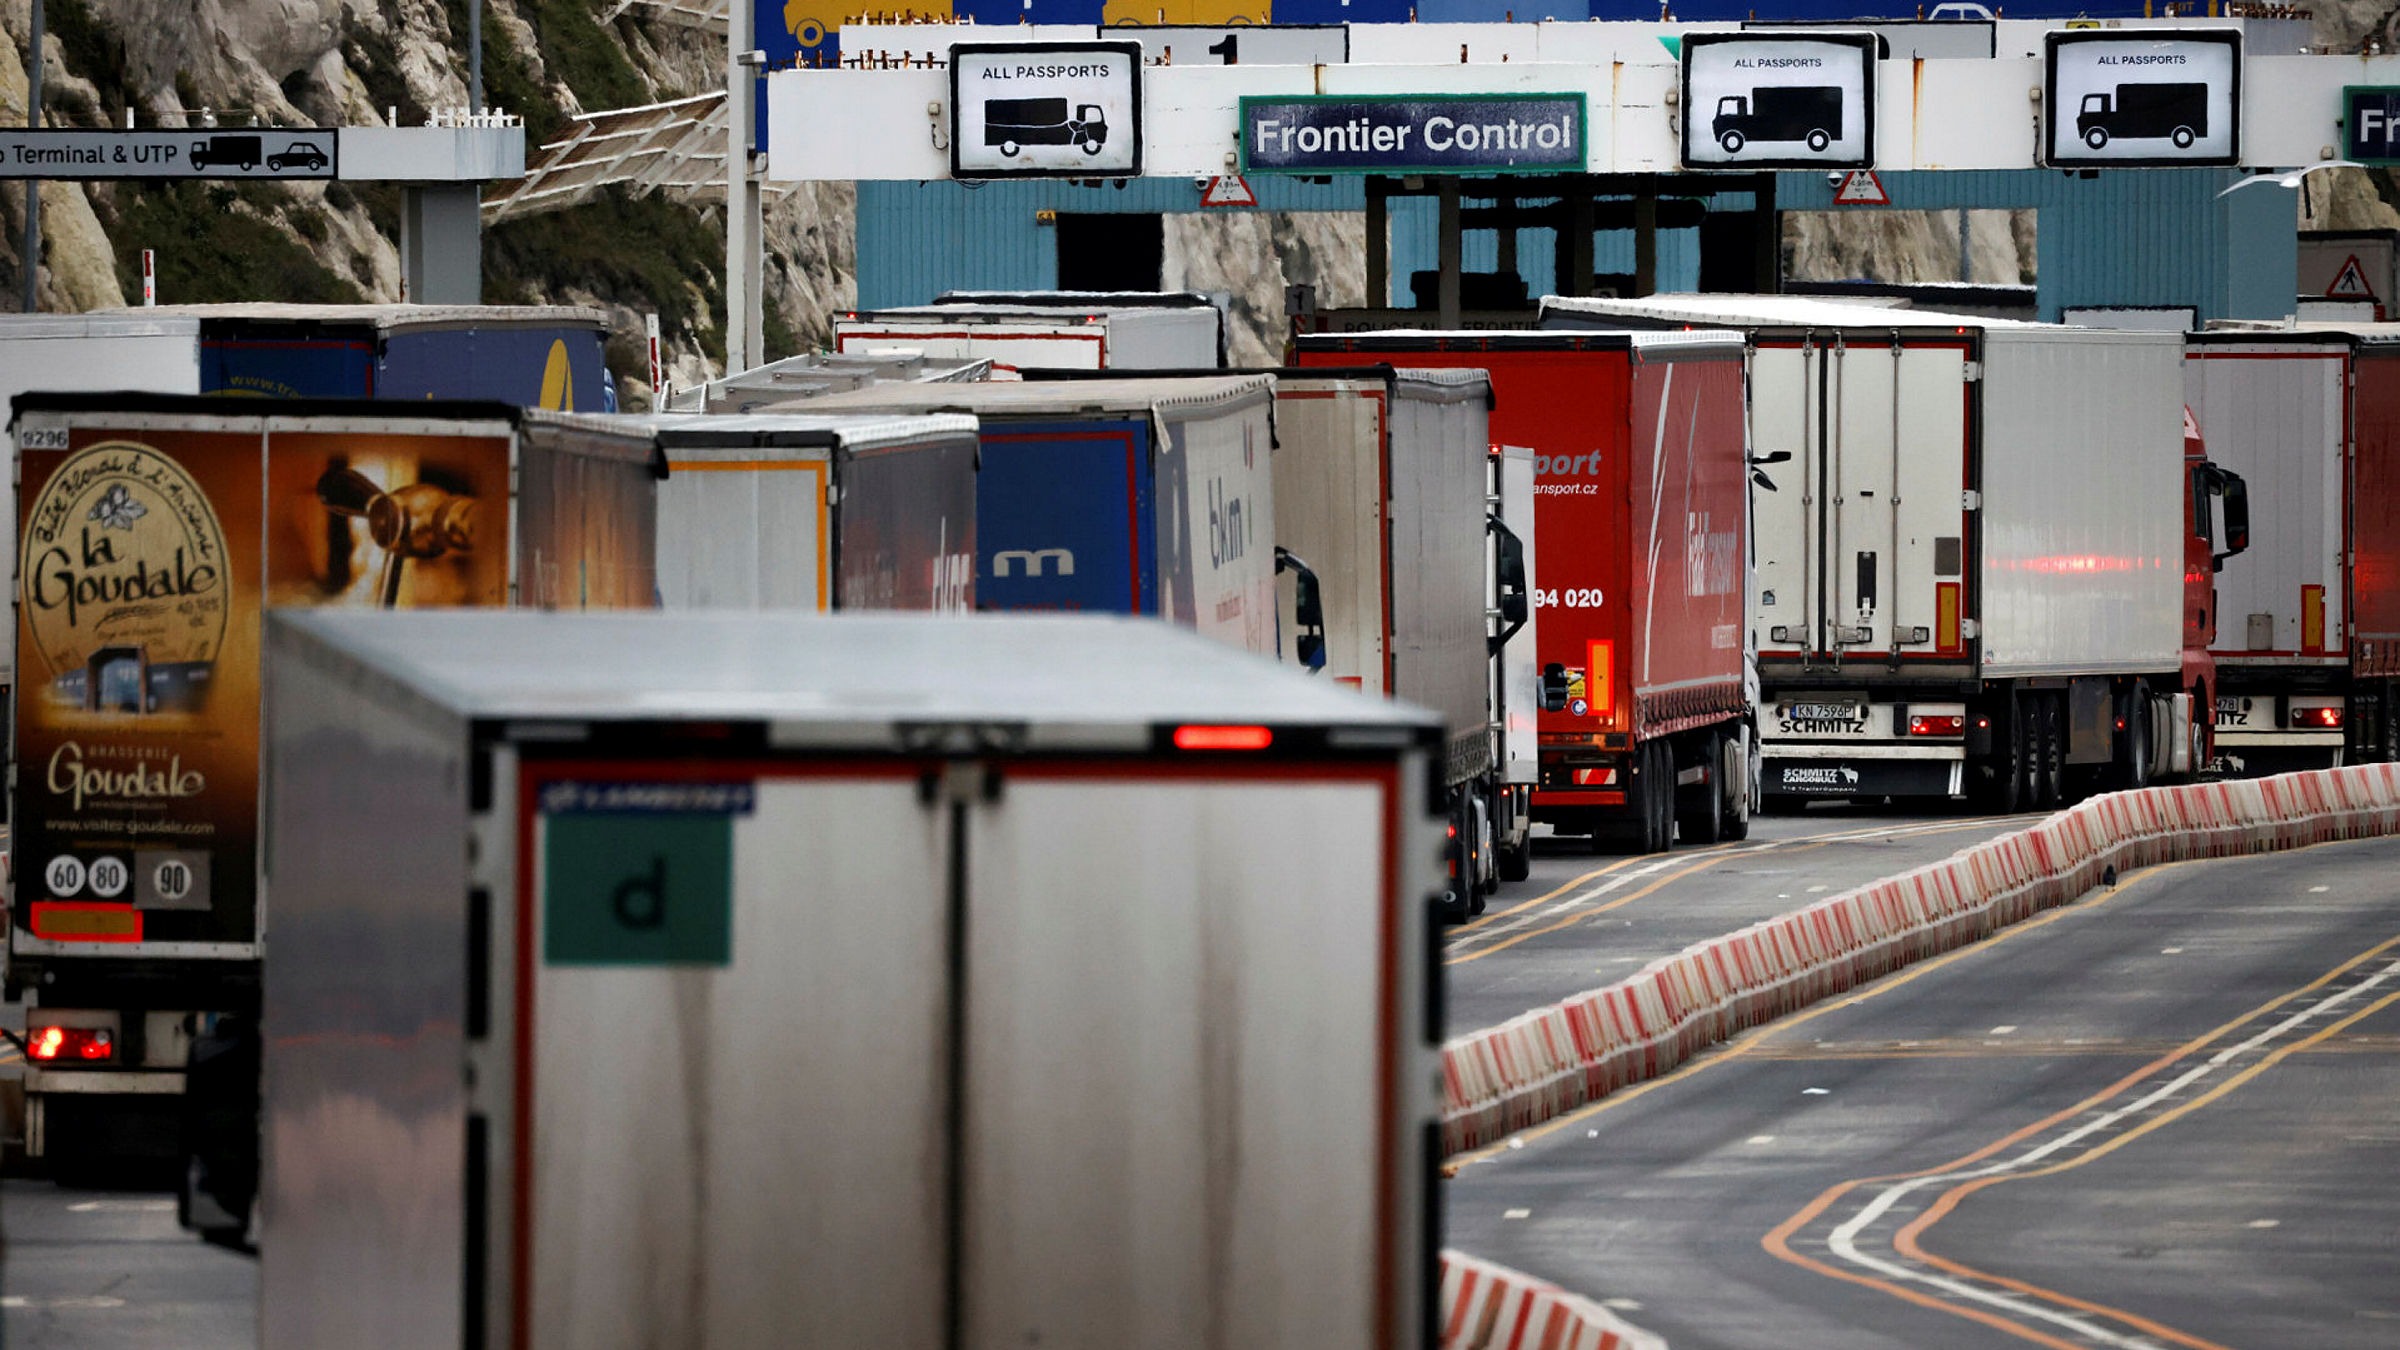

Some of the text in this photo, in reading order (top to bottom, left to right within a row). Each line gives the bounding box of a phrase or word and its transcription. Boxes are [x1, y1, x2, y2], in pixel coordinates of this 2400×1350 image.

[1734, 58, 1822, 68] ALL PASSPORTS
[2097, 55, 2187, 65] ALL PASSPORTS
[982, 64, 1110, 79] ALL PASSPORTS
[1257, 115, 1571, 153] Frontier Control
[12, 145, 105, 164] Terminal
[113, 145, 127, 163] &
[133, 145, 178, 164] UTP
[22, 431, 67, 446] 9296
[1208, 476, 1243, 570] bkm
[82, 526, 126, 568] la
[976, 549, 1074, 578] m
[33, 547, 217, 627] Goudale
[1565, 588, 1603, 608] 020
[1799, 704, 1852, 717] KN 7596P
[2216, 713, 2248, 725] ITZ
[1780, 721, 1864, 733] SCHMITZ
[48, 740, 206, 812] Goudale
[1784, 768, 1838, 776] SCHMITZ
[53, 863, 120, 889] 60 80
[160, 865, 185, 894] 90
[613, 854, 667, 932] d
